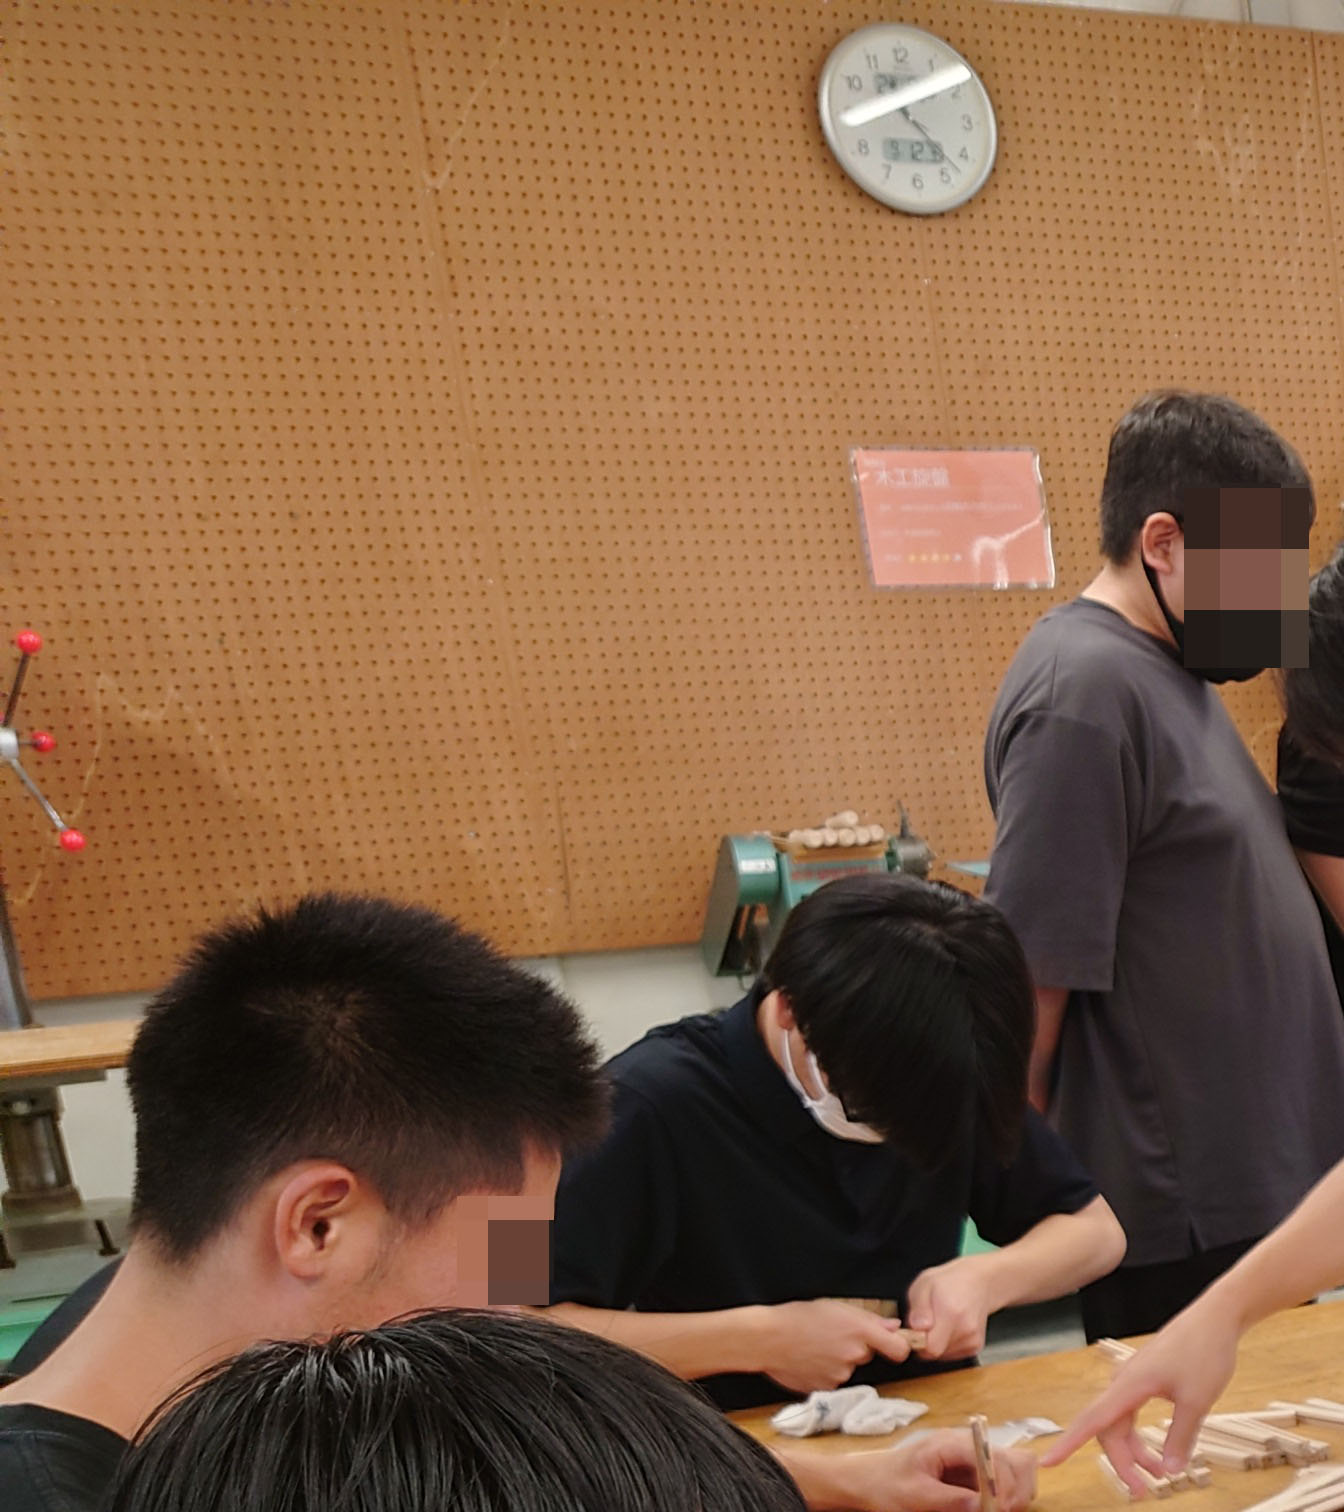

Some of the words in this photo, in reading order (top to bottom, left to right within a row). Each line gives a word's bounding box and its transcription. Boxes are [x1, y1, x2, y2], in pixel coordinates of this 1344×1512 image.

[866, 54, 879, 69] 11
[893, 48, 908, 64] 12
[928, 58, 935, 73] 1
[846, 75, 864, 92] 10
[962, 114, 973, 131] 3
[858, 138, 870, 156] 8
[959, 146, 969, 160] 4
[881, 163, 892, 180] 7
[940, 167, 951, 184] 5
[912, 173, 924, 190] 6
